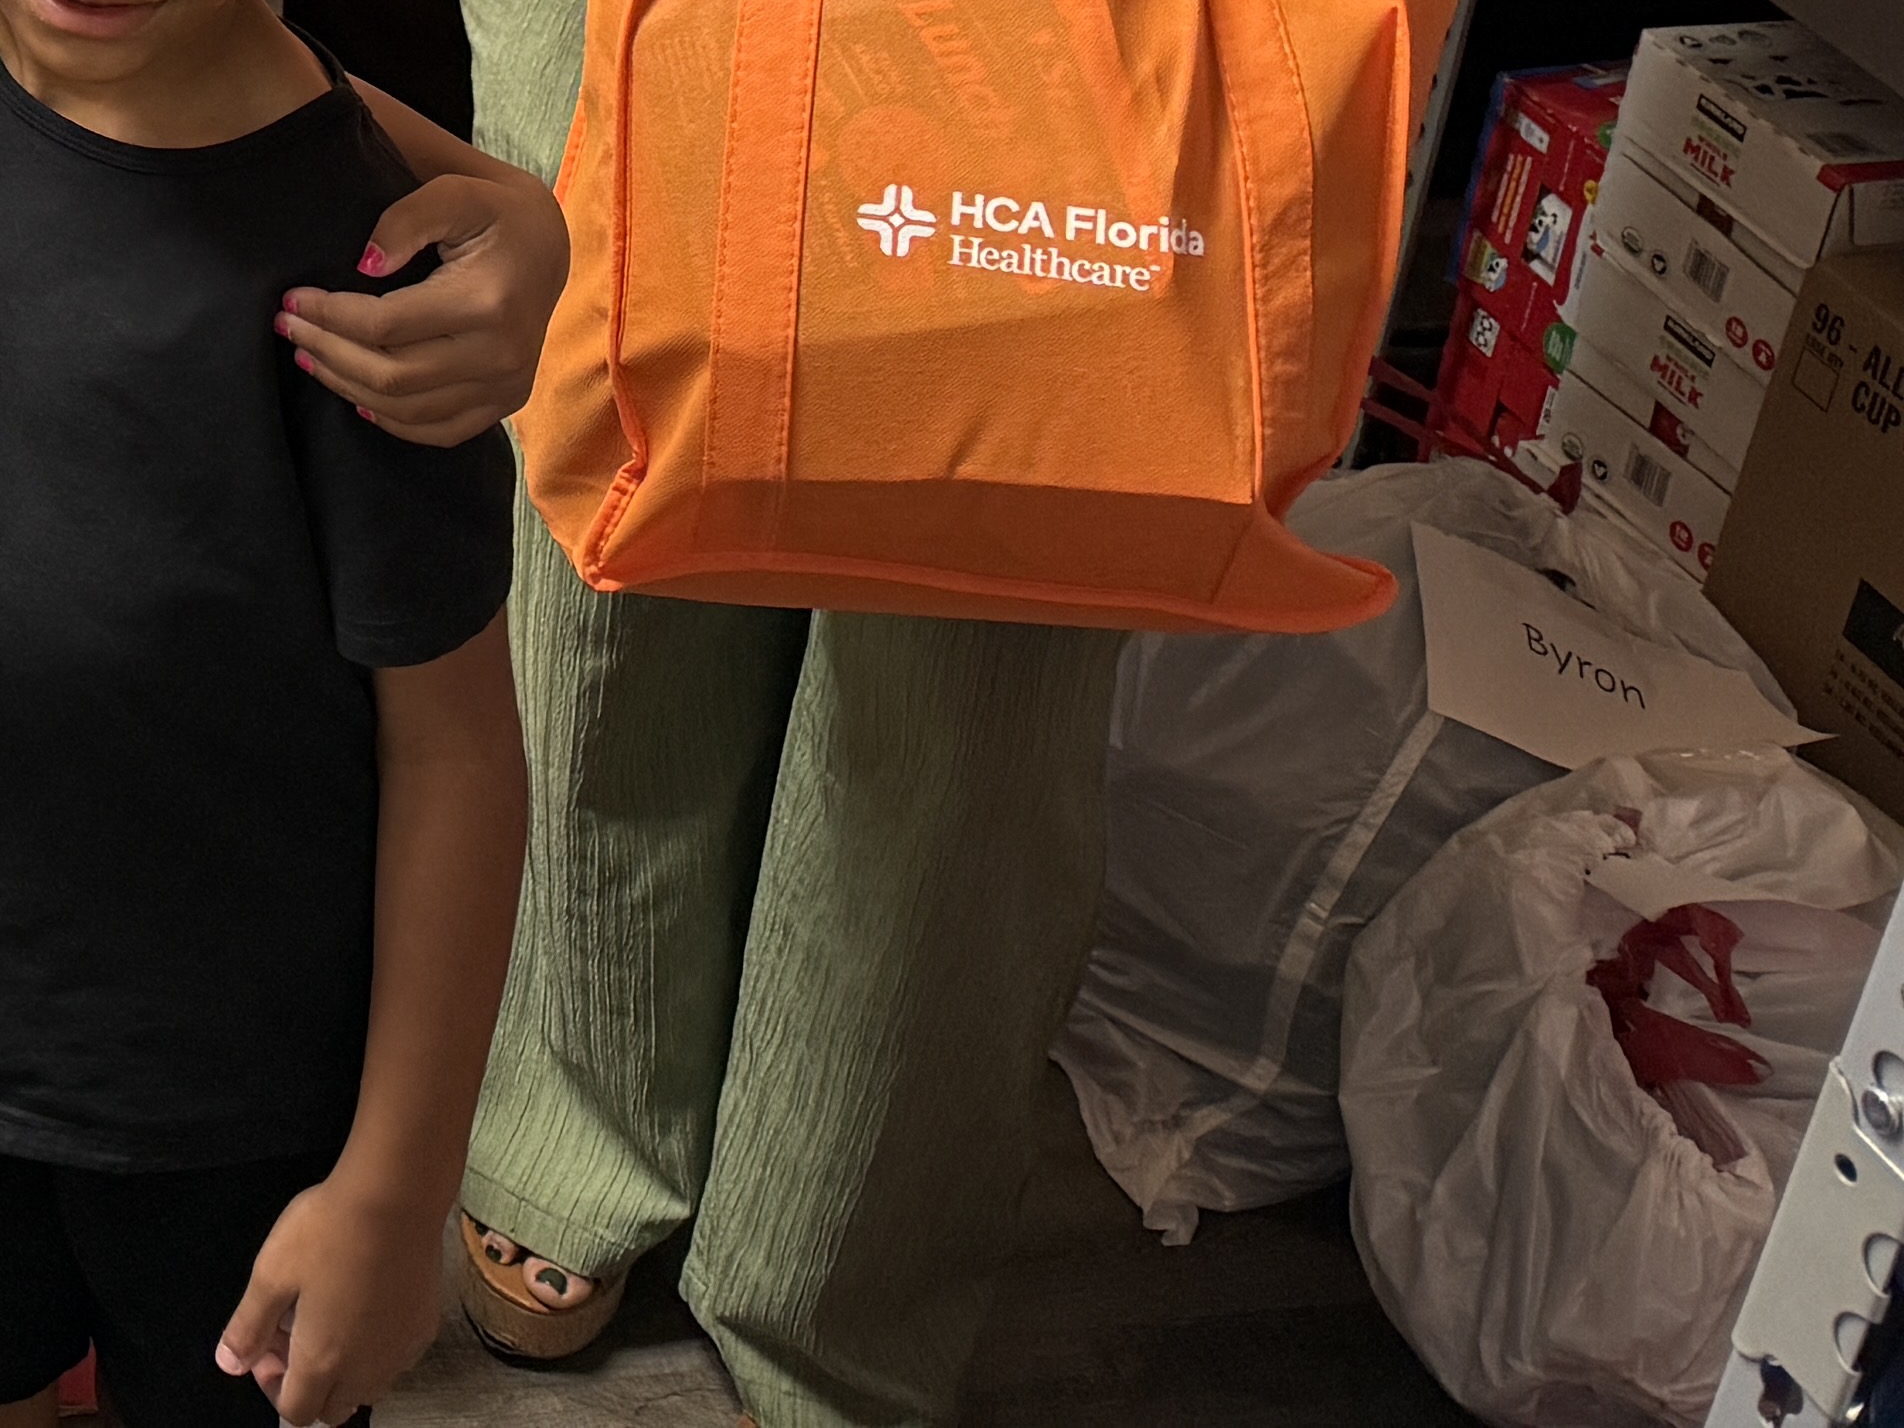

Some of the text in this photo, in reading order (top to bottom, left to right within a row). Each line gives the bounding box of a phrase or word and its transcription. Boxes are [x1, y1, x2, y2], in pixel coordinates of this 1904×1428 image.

[1683, 134, 1737, 189] MILK
[950, 189, 1206, 258] HCA Florida
[947, 233, 1150, 292] Healthcare
[1812, 303, 1845, 345] 96
[1649, 353, 1705, 410] MILK
[1851, 380, 1902, 435] CUP
[1520, 620, 1648, 712] Byron
